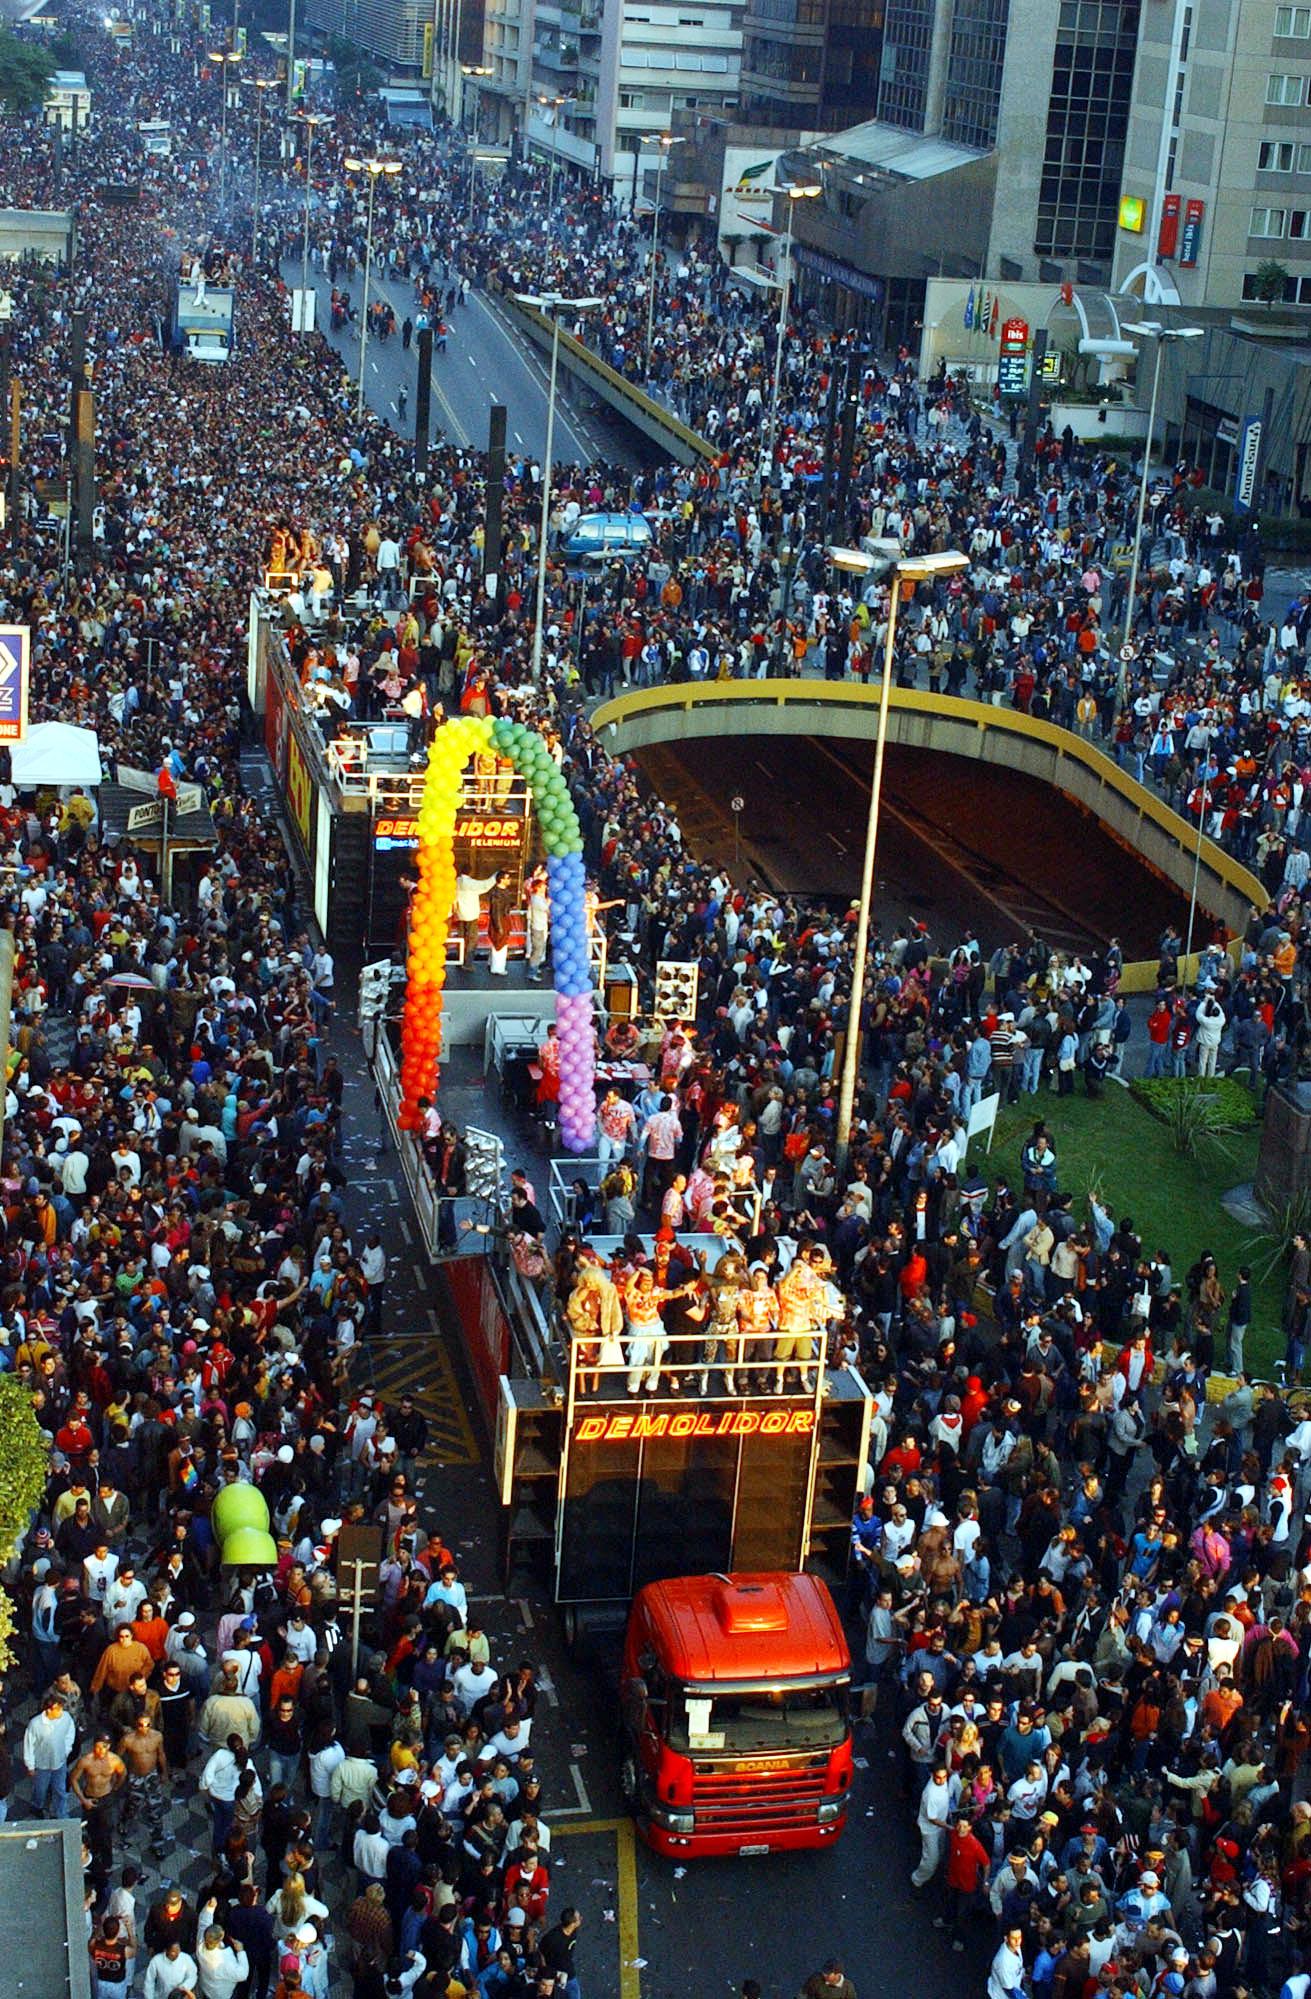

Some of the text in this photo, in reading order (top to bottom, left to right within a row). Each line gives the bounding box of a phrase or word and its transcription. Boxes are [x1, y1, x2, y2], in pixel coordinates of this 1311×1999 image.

[1008, 330, 1024, 340] ibis
[575, 1411, 815, 1441] DEMOLIDOR
[735, 1760, 790, 1772] SCANIA
